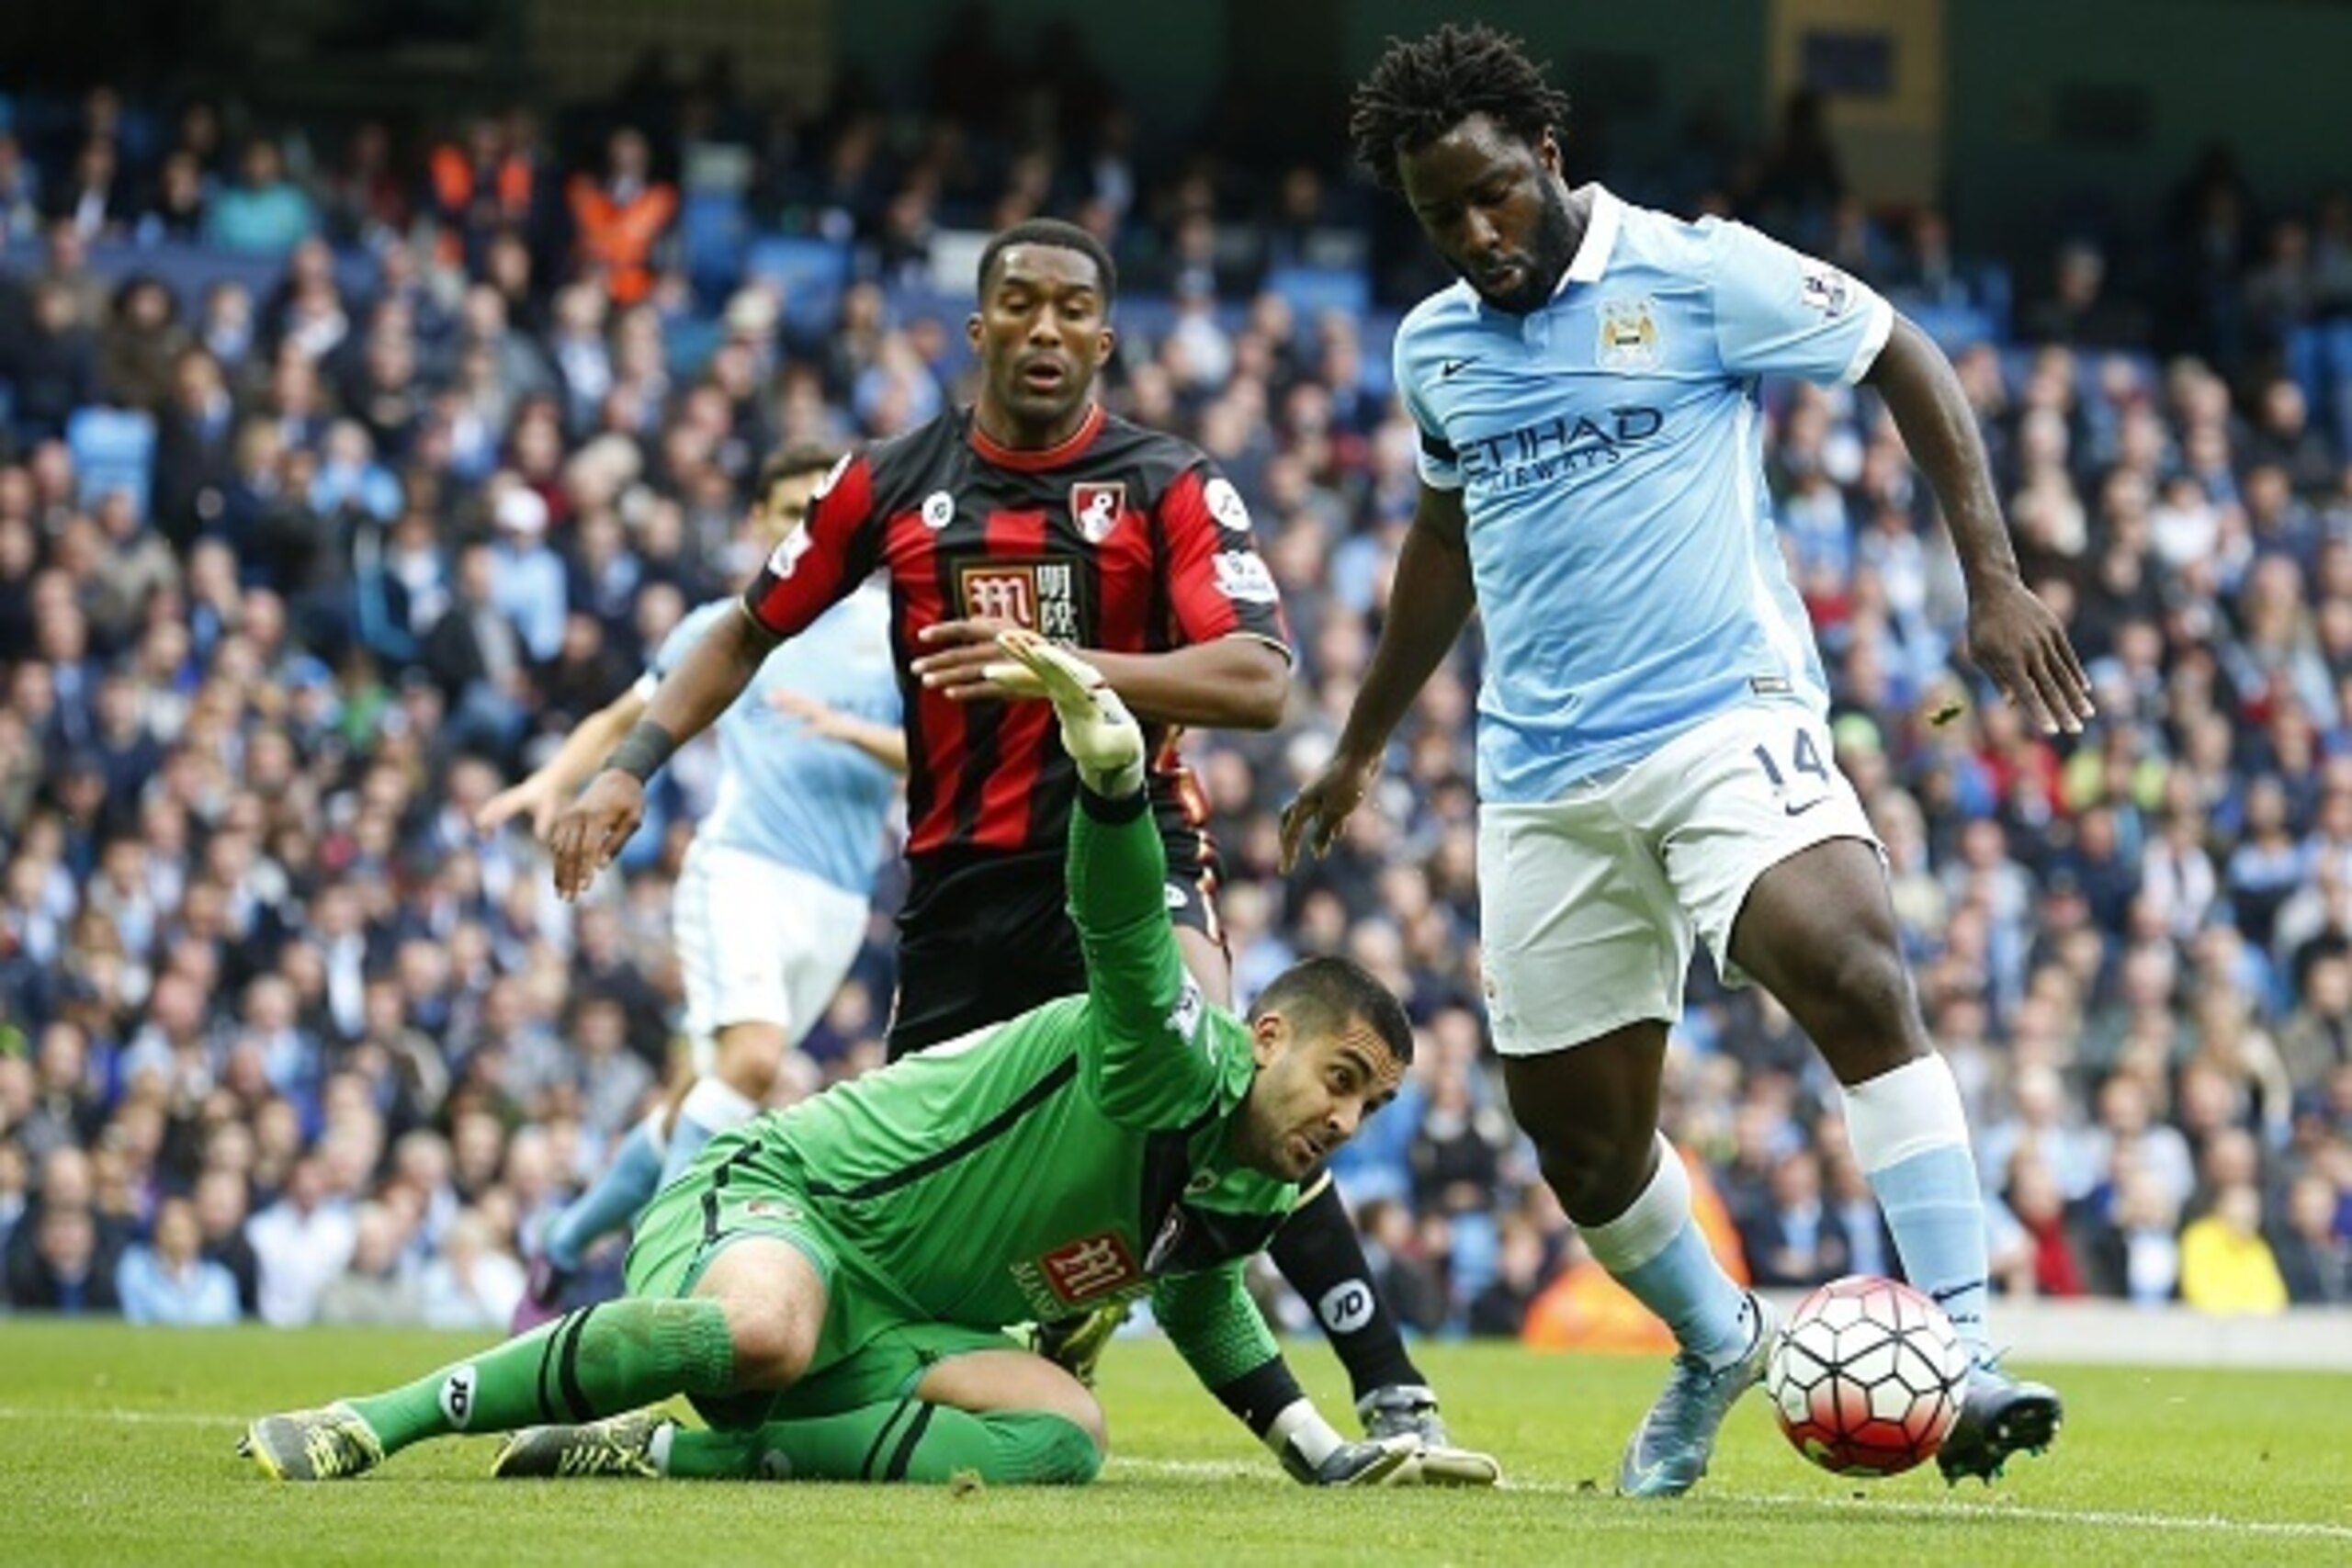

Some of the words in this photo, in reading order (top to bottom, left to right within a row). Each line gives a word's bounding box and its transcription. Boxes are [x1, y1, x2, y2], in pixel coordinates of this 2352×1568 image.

[1457, 405, 1663, 476] ETIHAD
[1753, 727, 1829, 785] 14
[1333, 1290, 1363, 1325] JD
[450, 1377, 469, 1418] JD
